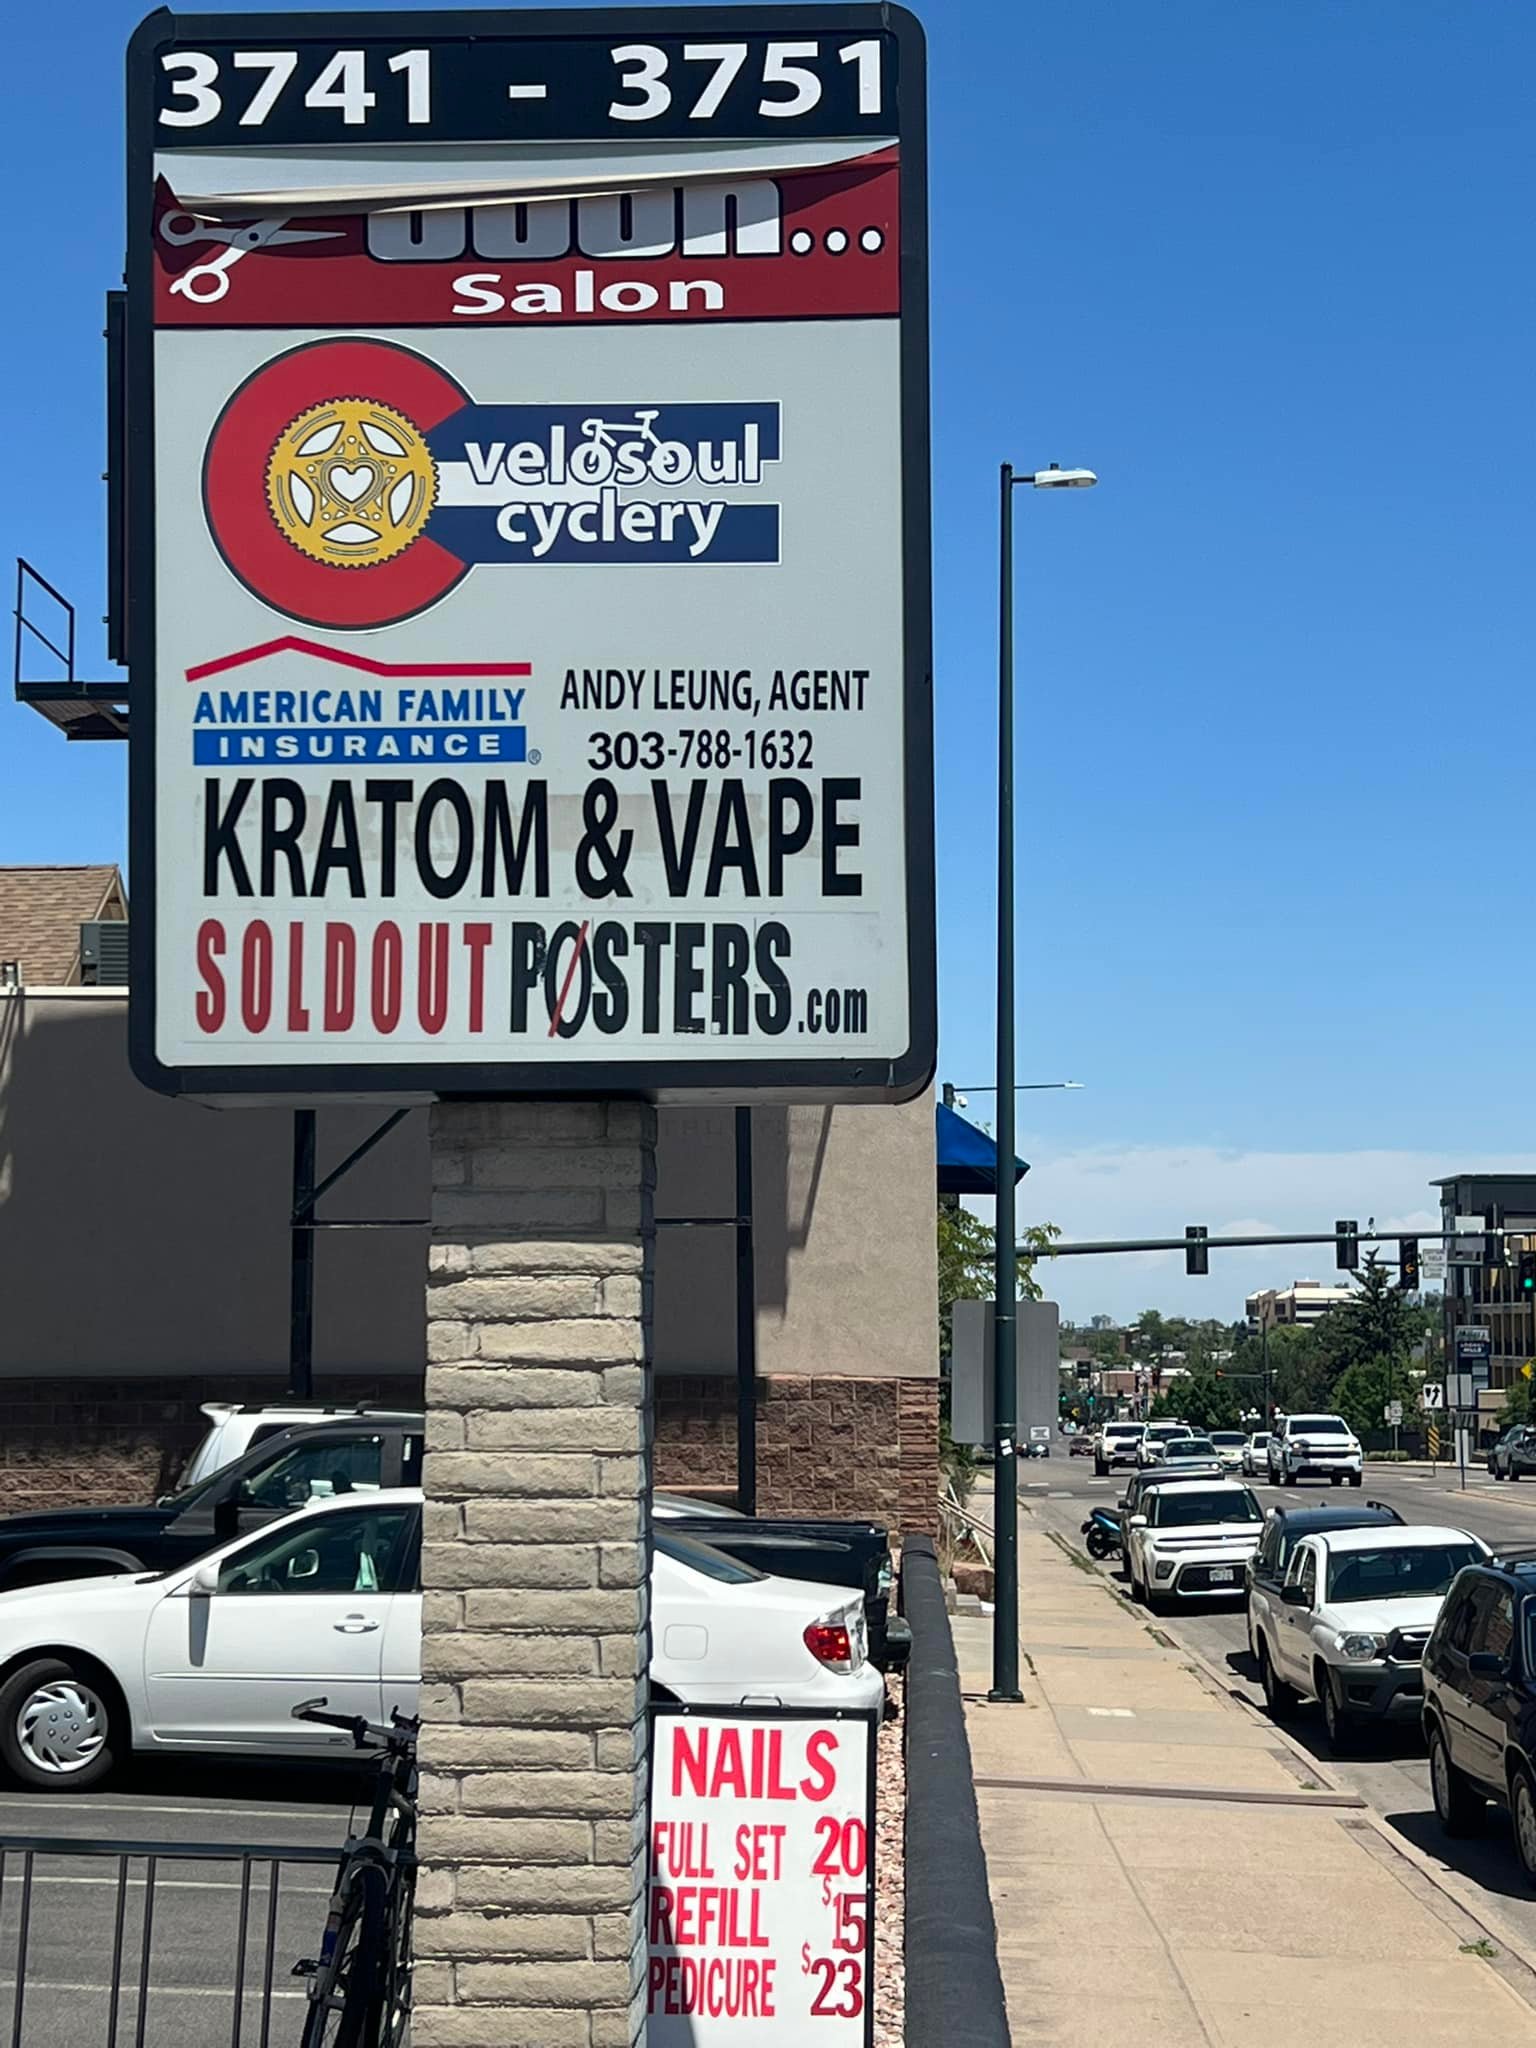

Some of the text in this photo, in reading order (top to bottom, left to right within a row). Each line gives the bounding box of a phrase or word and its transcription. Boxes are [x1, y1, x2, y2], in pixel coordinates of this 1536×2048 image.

[158, 49, 430, 127] 3741
[608, 39, 881, 121] 3751
[452, 270, 724, 315] Salon
[464, 422, 760, 485] velosoul
[496, 487, 725, 557] cyclery
[193, 688, 525, 724] AMERICAN FAMILY
[560, 669, 870, 717] ANDY LEUNG, AGENT
[220, 732, 500, 758] INSURANCE
[587, 729, 814, 770] 303-788-1632
[203, 777, 863, 900] KRATOM & VAPE
[671, 1726, 839, 1802] NAILS
[652, 1815, 867, 1881] FULL SET 20
[650, 1886, 770, 1947] REFILL
[648, 1941, 864, 2019] PEDICURE $23
